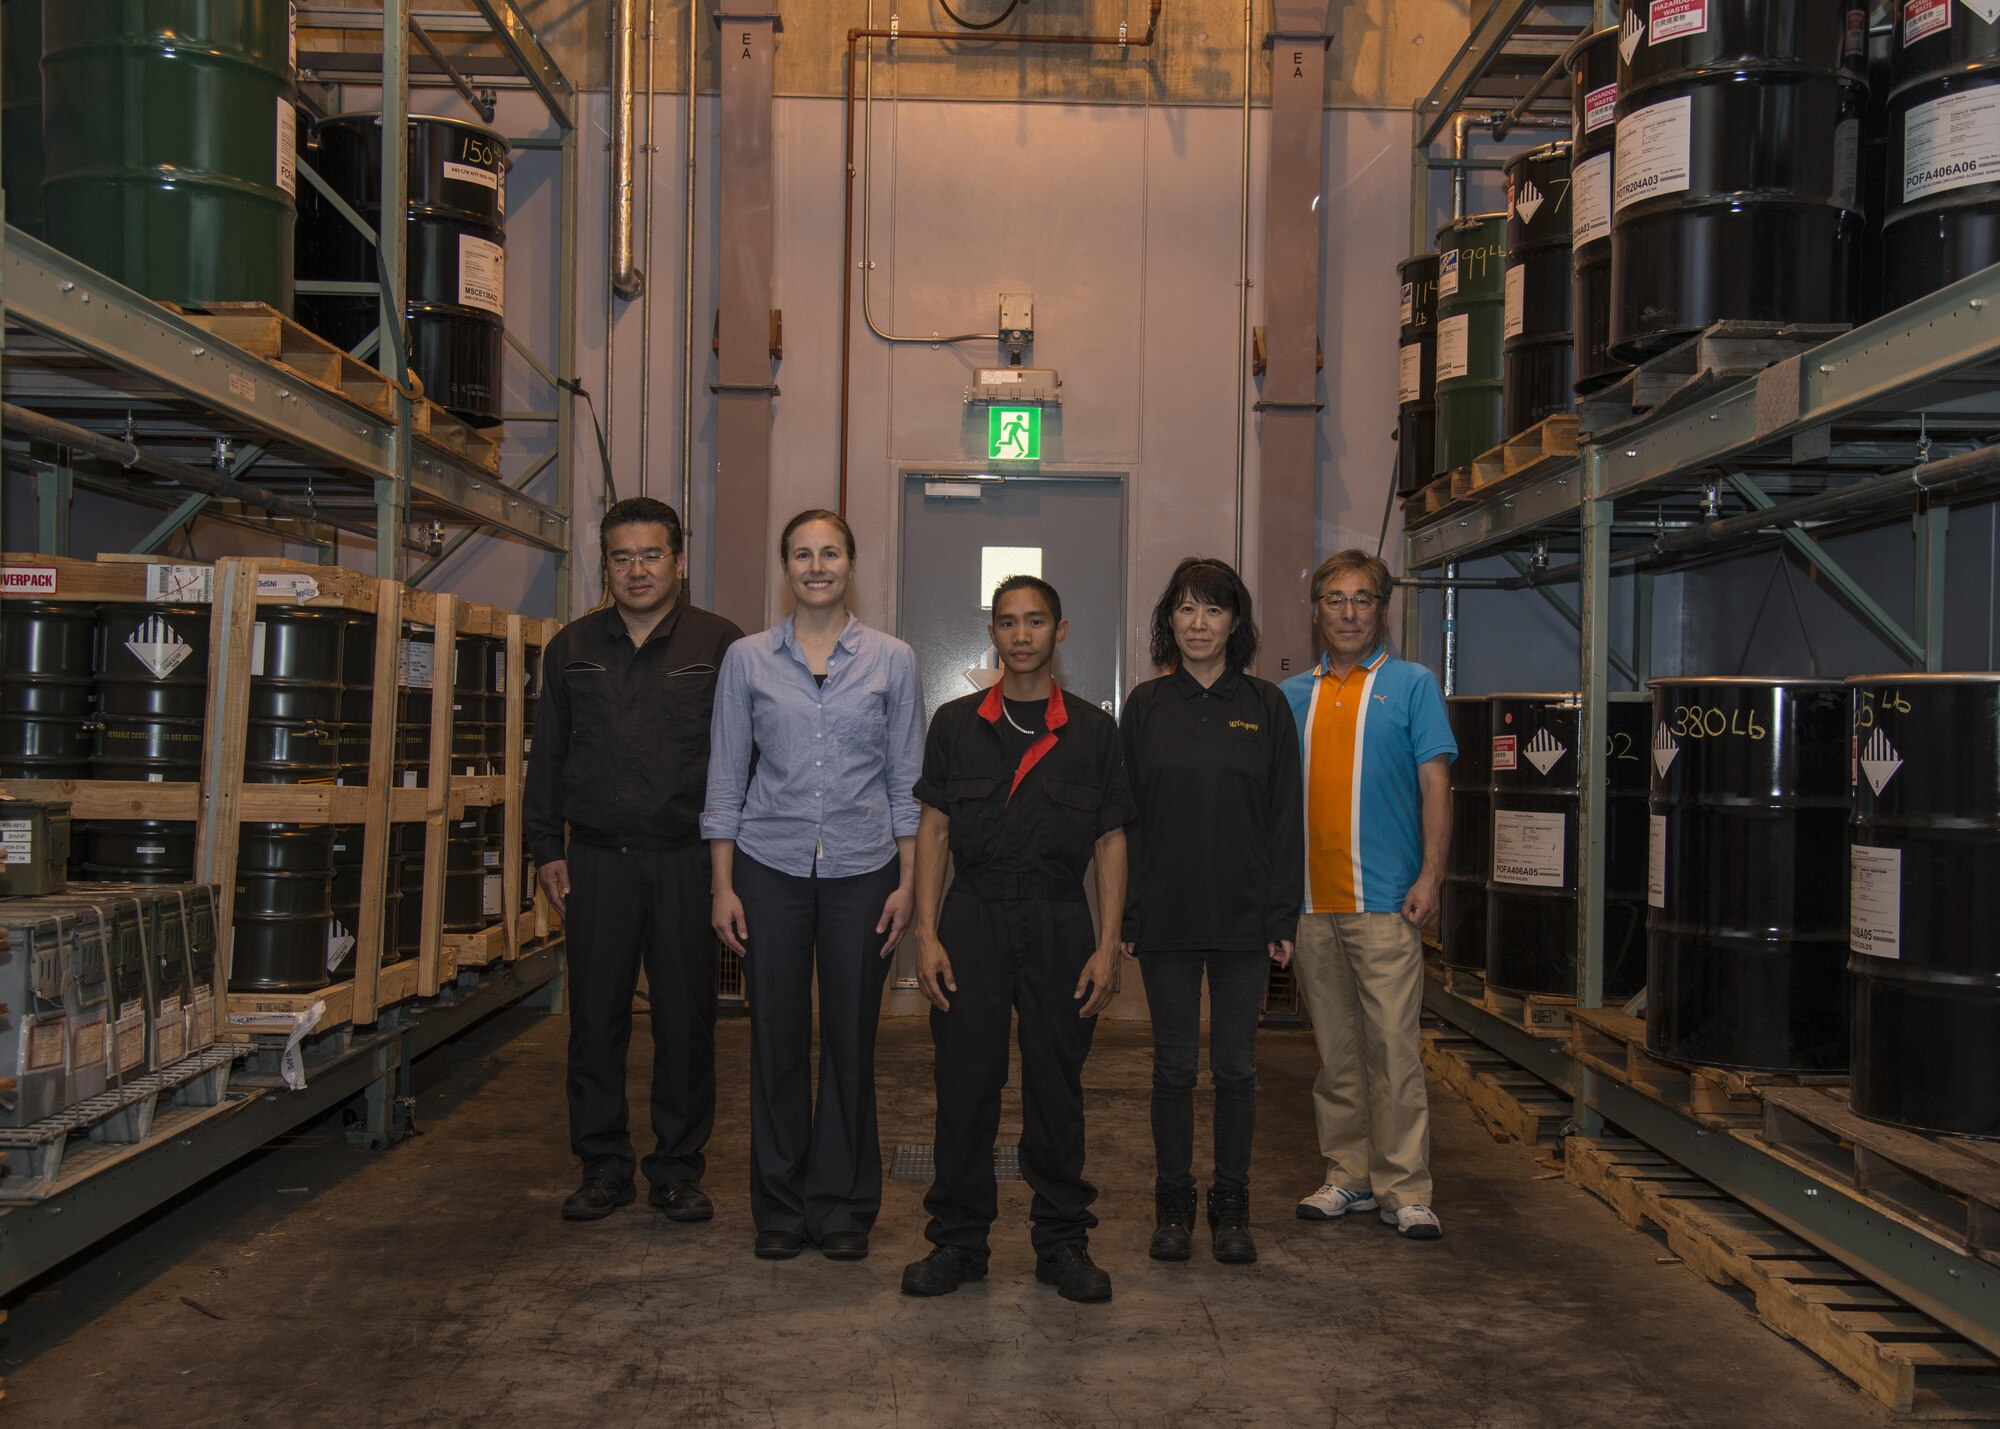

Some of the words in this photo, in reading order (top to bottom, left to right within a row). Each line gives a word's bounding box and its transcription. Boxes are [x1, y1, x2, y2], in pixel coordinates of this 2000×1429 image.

[1663, 4, 1690, 16] WASTE
[742, 33, 752, 45] E
[742, 47, 752, 59] A
[1294, 52, 1303, 64] E
[1293, 66, 1303, 78] A
[1593, 95, 1614, 107] WASTE
[462, 136, 494, 166] 150
[1906, 160, 1977, 189] POFA406A06
[1461, 247, 1487, 280] 99
[1281, 658, 1290, 671] E
[1669, 704, 1727, 739] 380
[1731, 708, 1767, 740] Lb
[1496, 865, 1539, 877] POFA406A05
